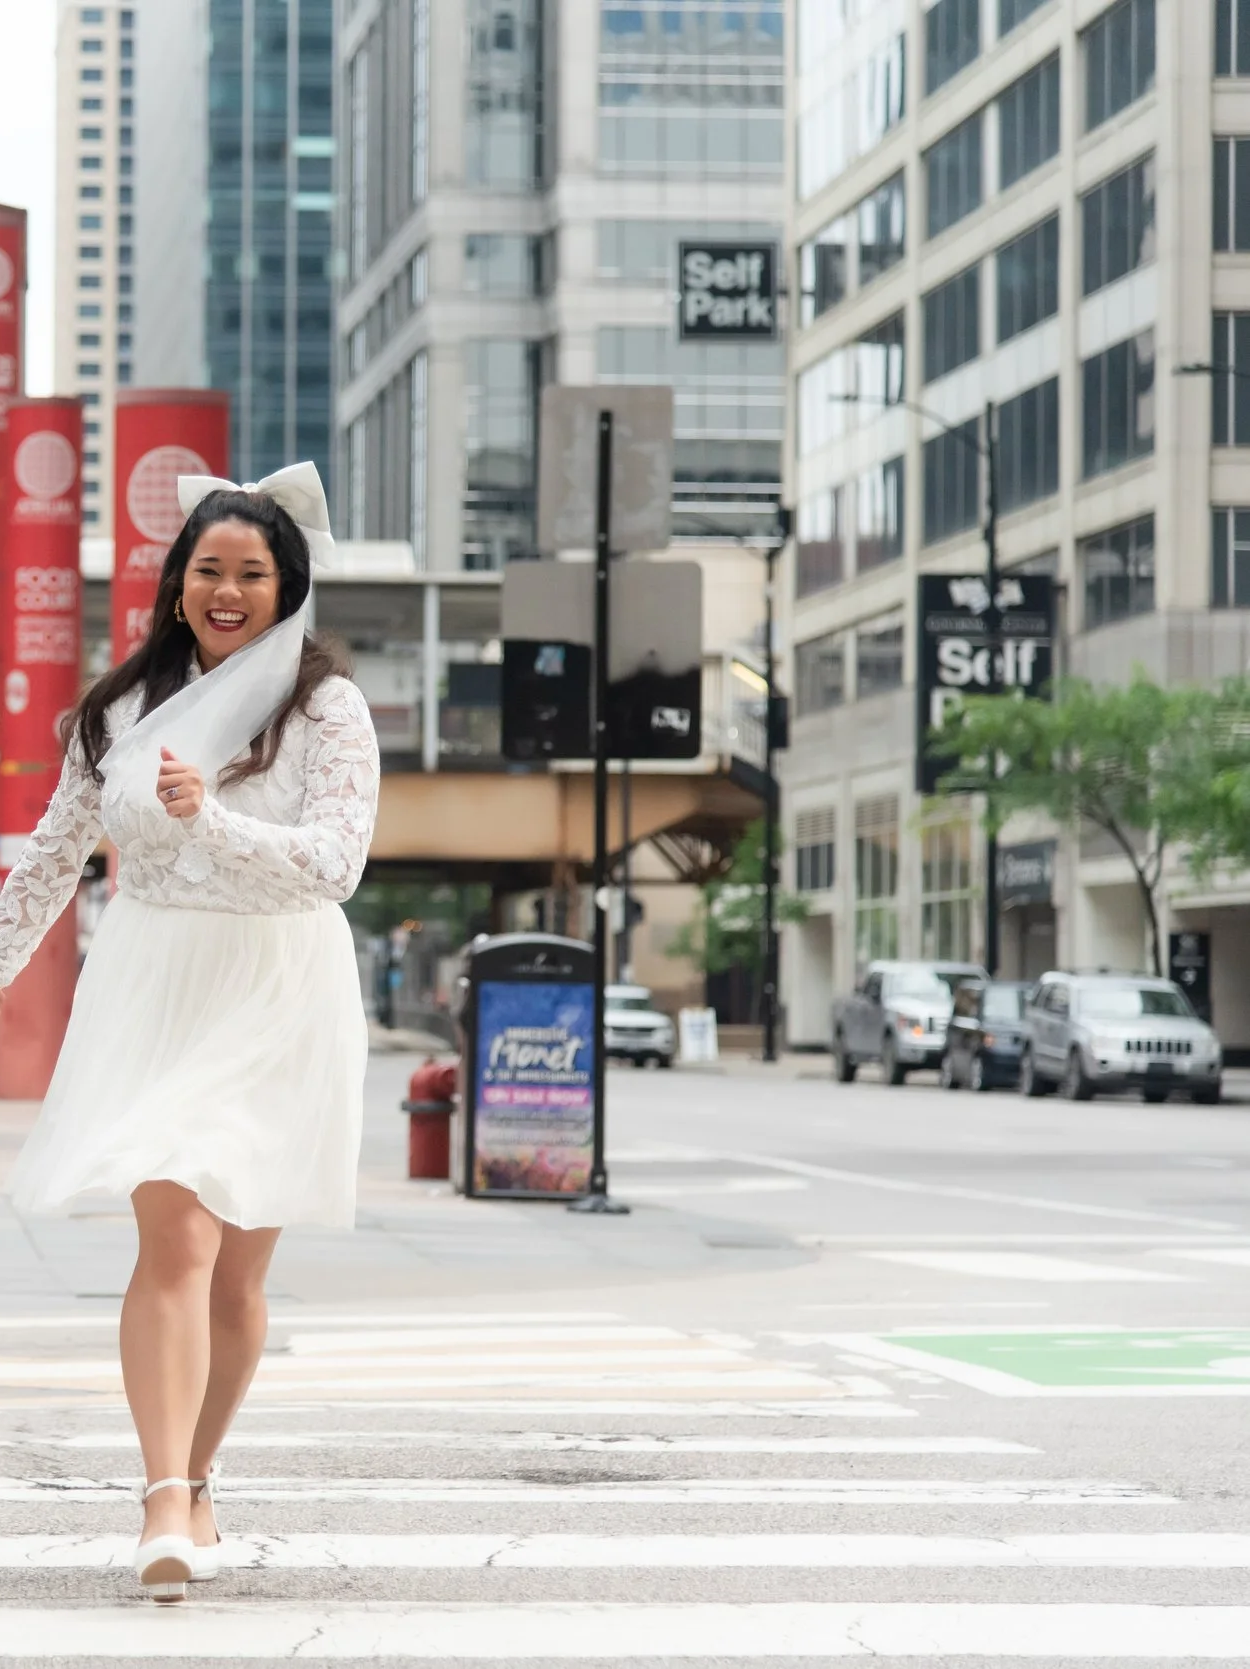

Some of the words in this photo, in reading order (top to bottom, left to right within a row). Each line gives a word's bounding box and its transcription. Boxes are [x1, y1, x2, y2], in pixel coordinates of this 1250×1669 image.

[684, 250, 764, 289] Self
[686, 290, 772, 327] Park
[15, 568, 77, 590] FOOD
